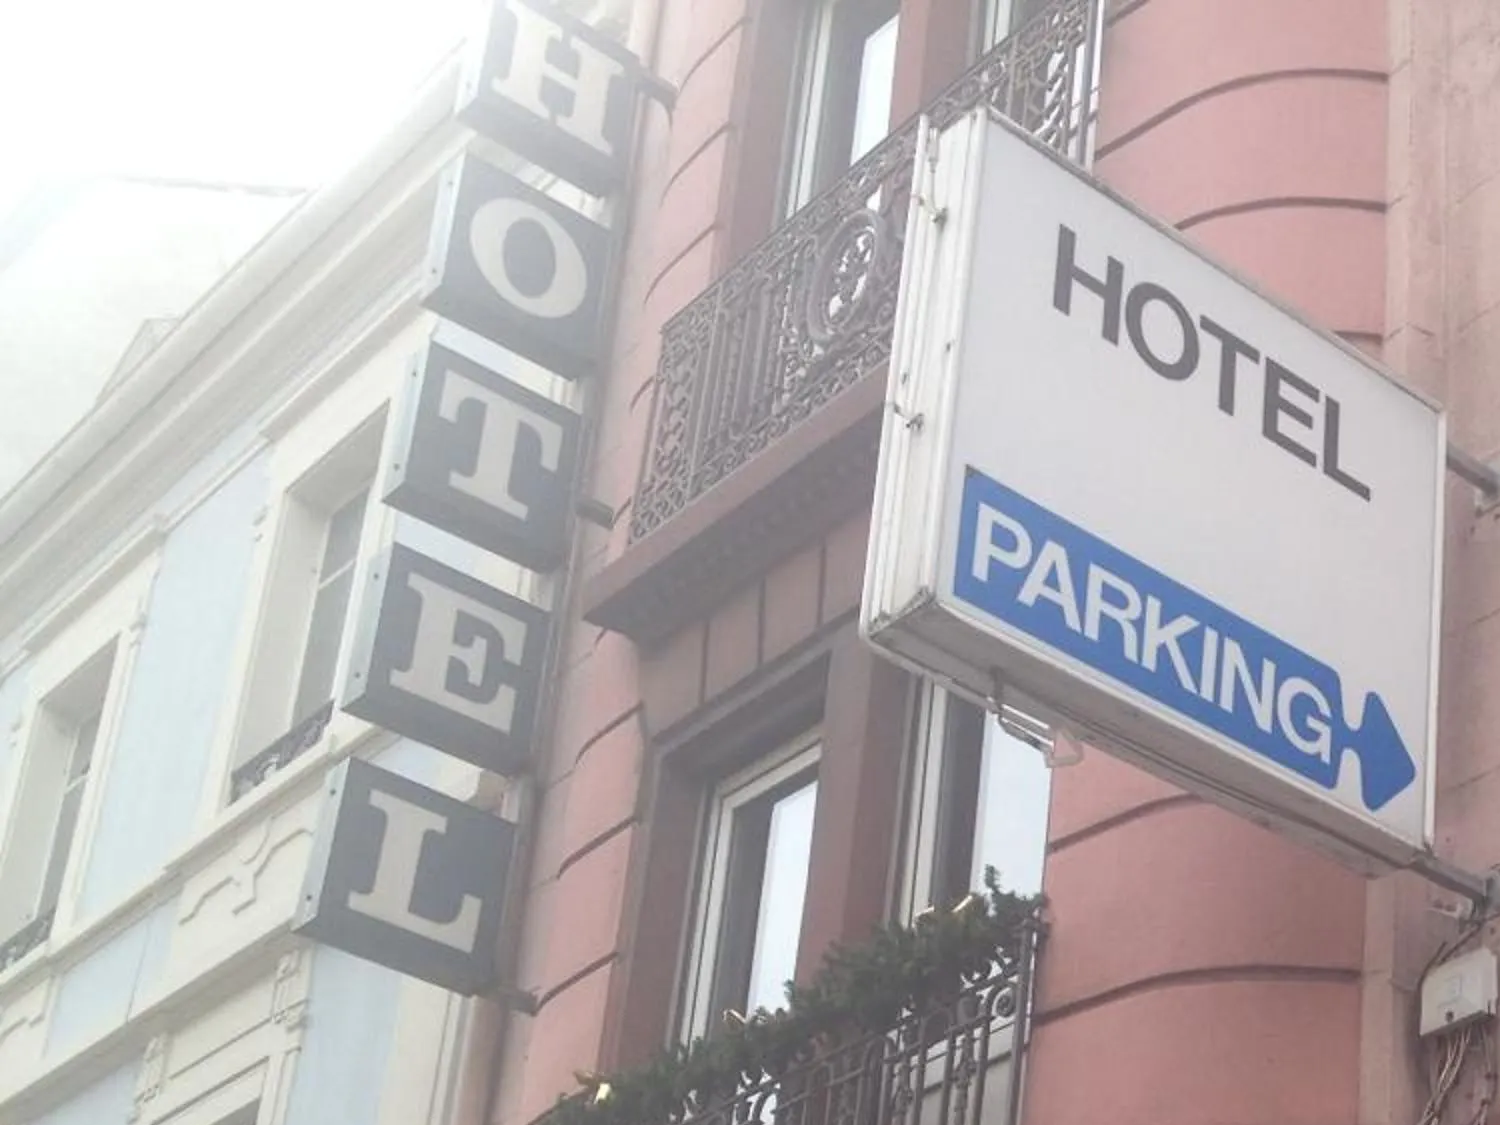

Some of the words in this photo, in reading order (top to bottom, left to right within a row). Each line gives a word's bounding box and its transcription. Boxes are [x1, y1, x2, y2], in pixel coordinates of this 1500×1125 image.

[346, 0, 625, 955] HOTEL
[1051, 222, 1372, 503] HOTEL
[971, 500, 1334, 767] PARKING
